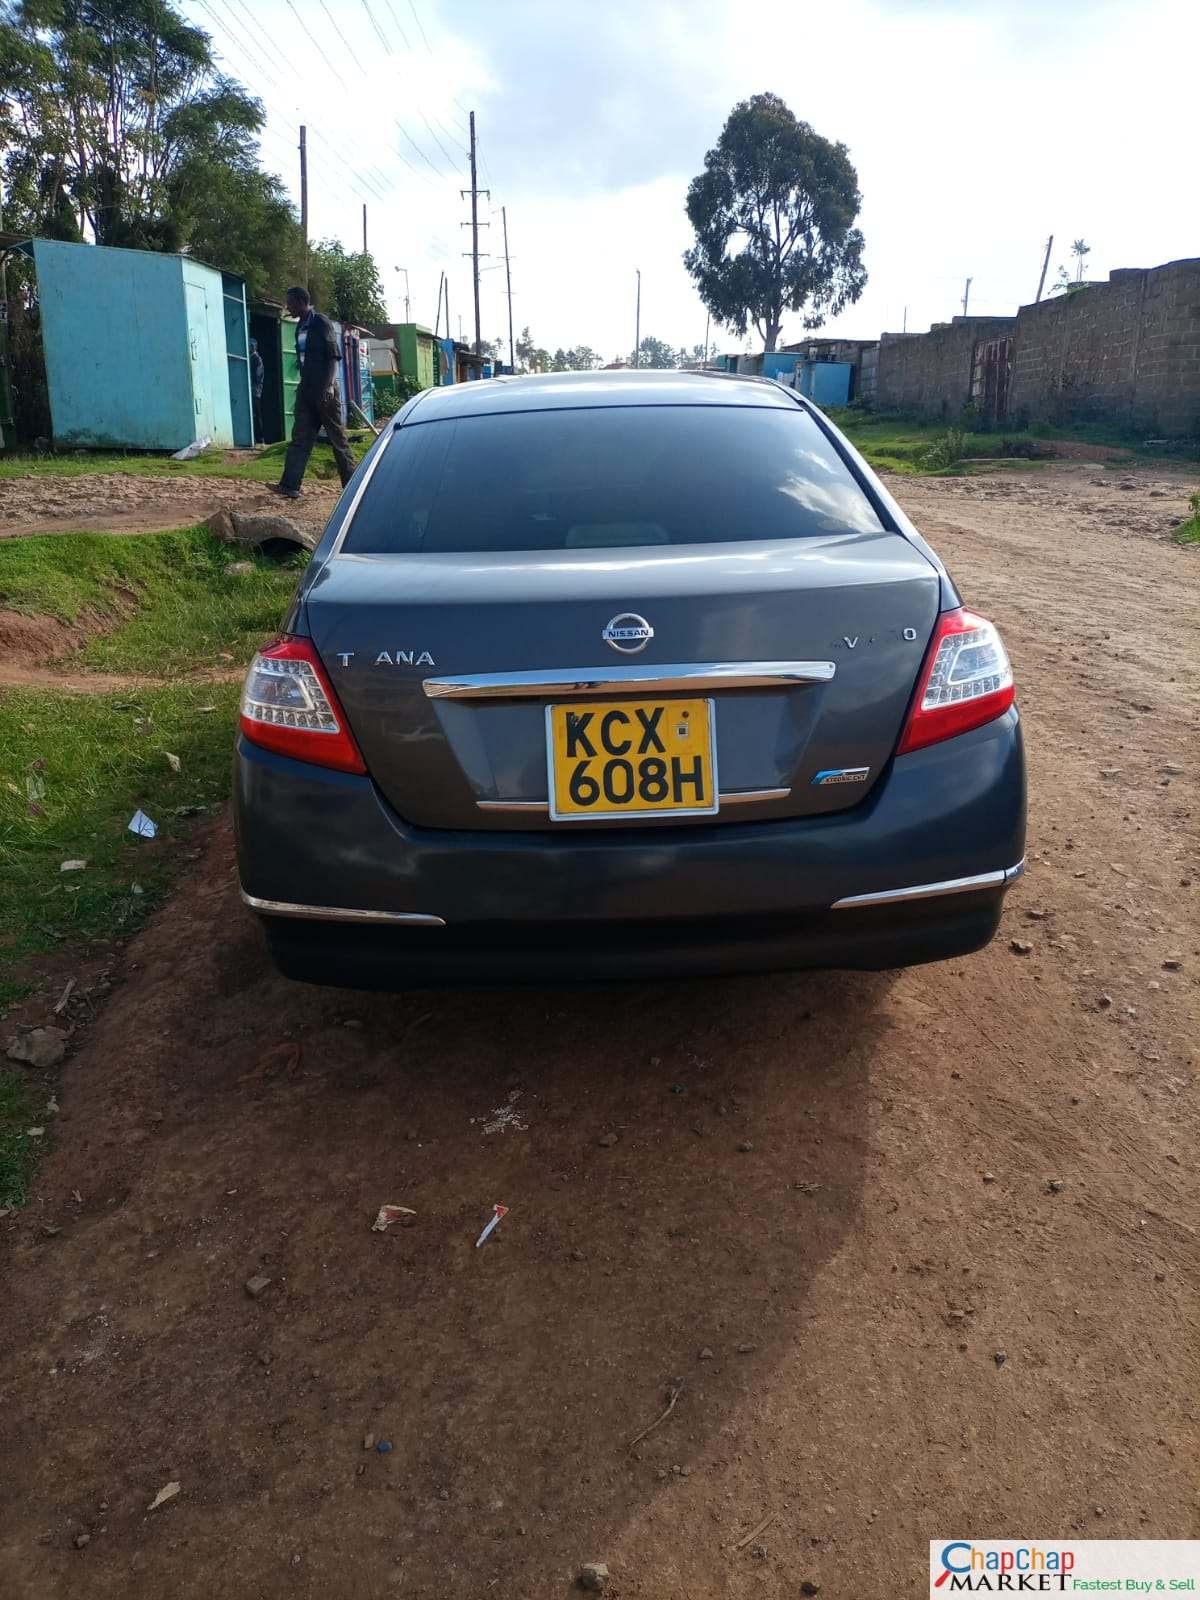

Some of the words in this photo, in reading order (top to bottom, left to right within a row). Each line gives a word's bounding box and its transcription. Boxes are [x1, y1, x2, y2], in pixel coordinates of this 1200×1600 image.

[608, 629, 649, 638] NISSAN
[565, 707, 666, 757] KCX
[569, 755, 704, 806] 608H
